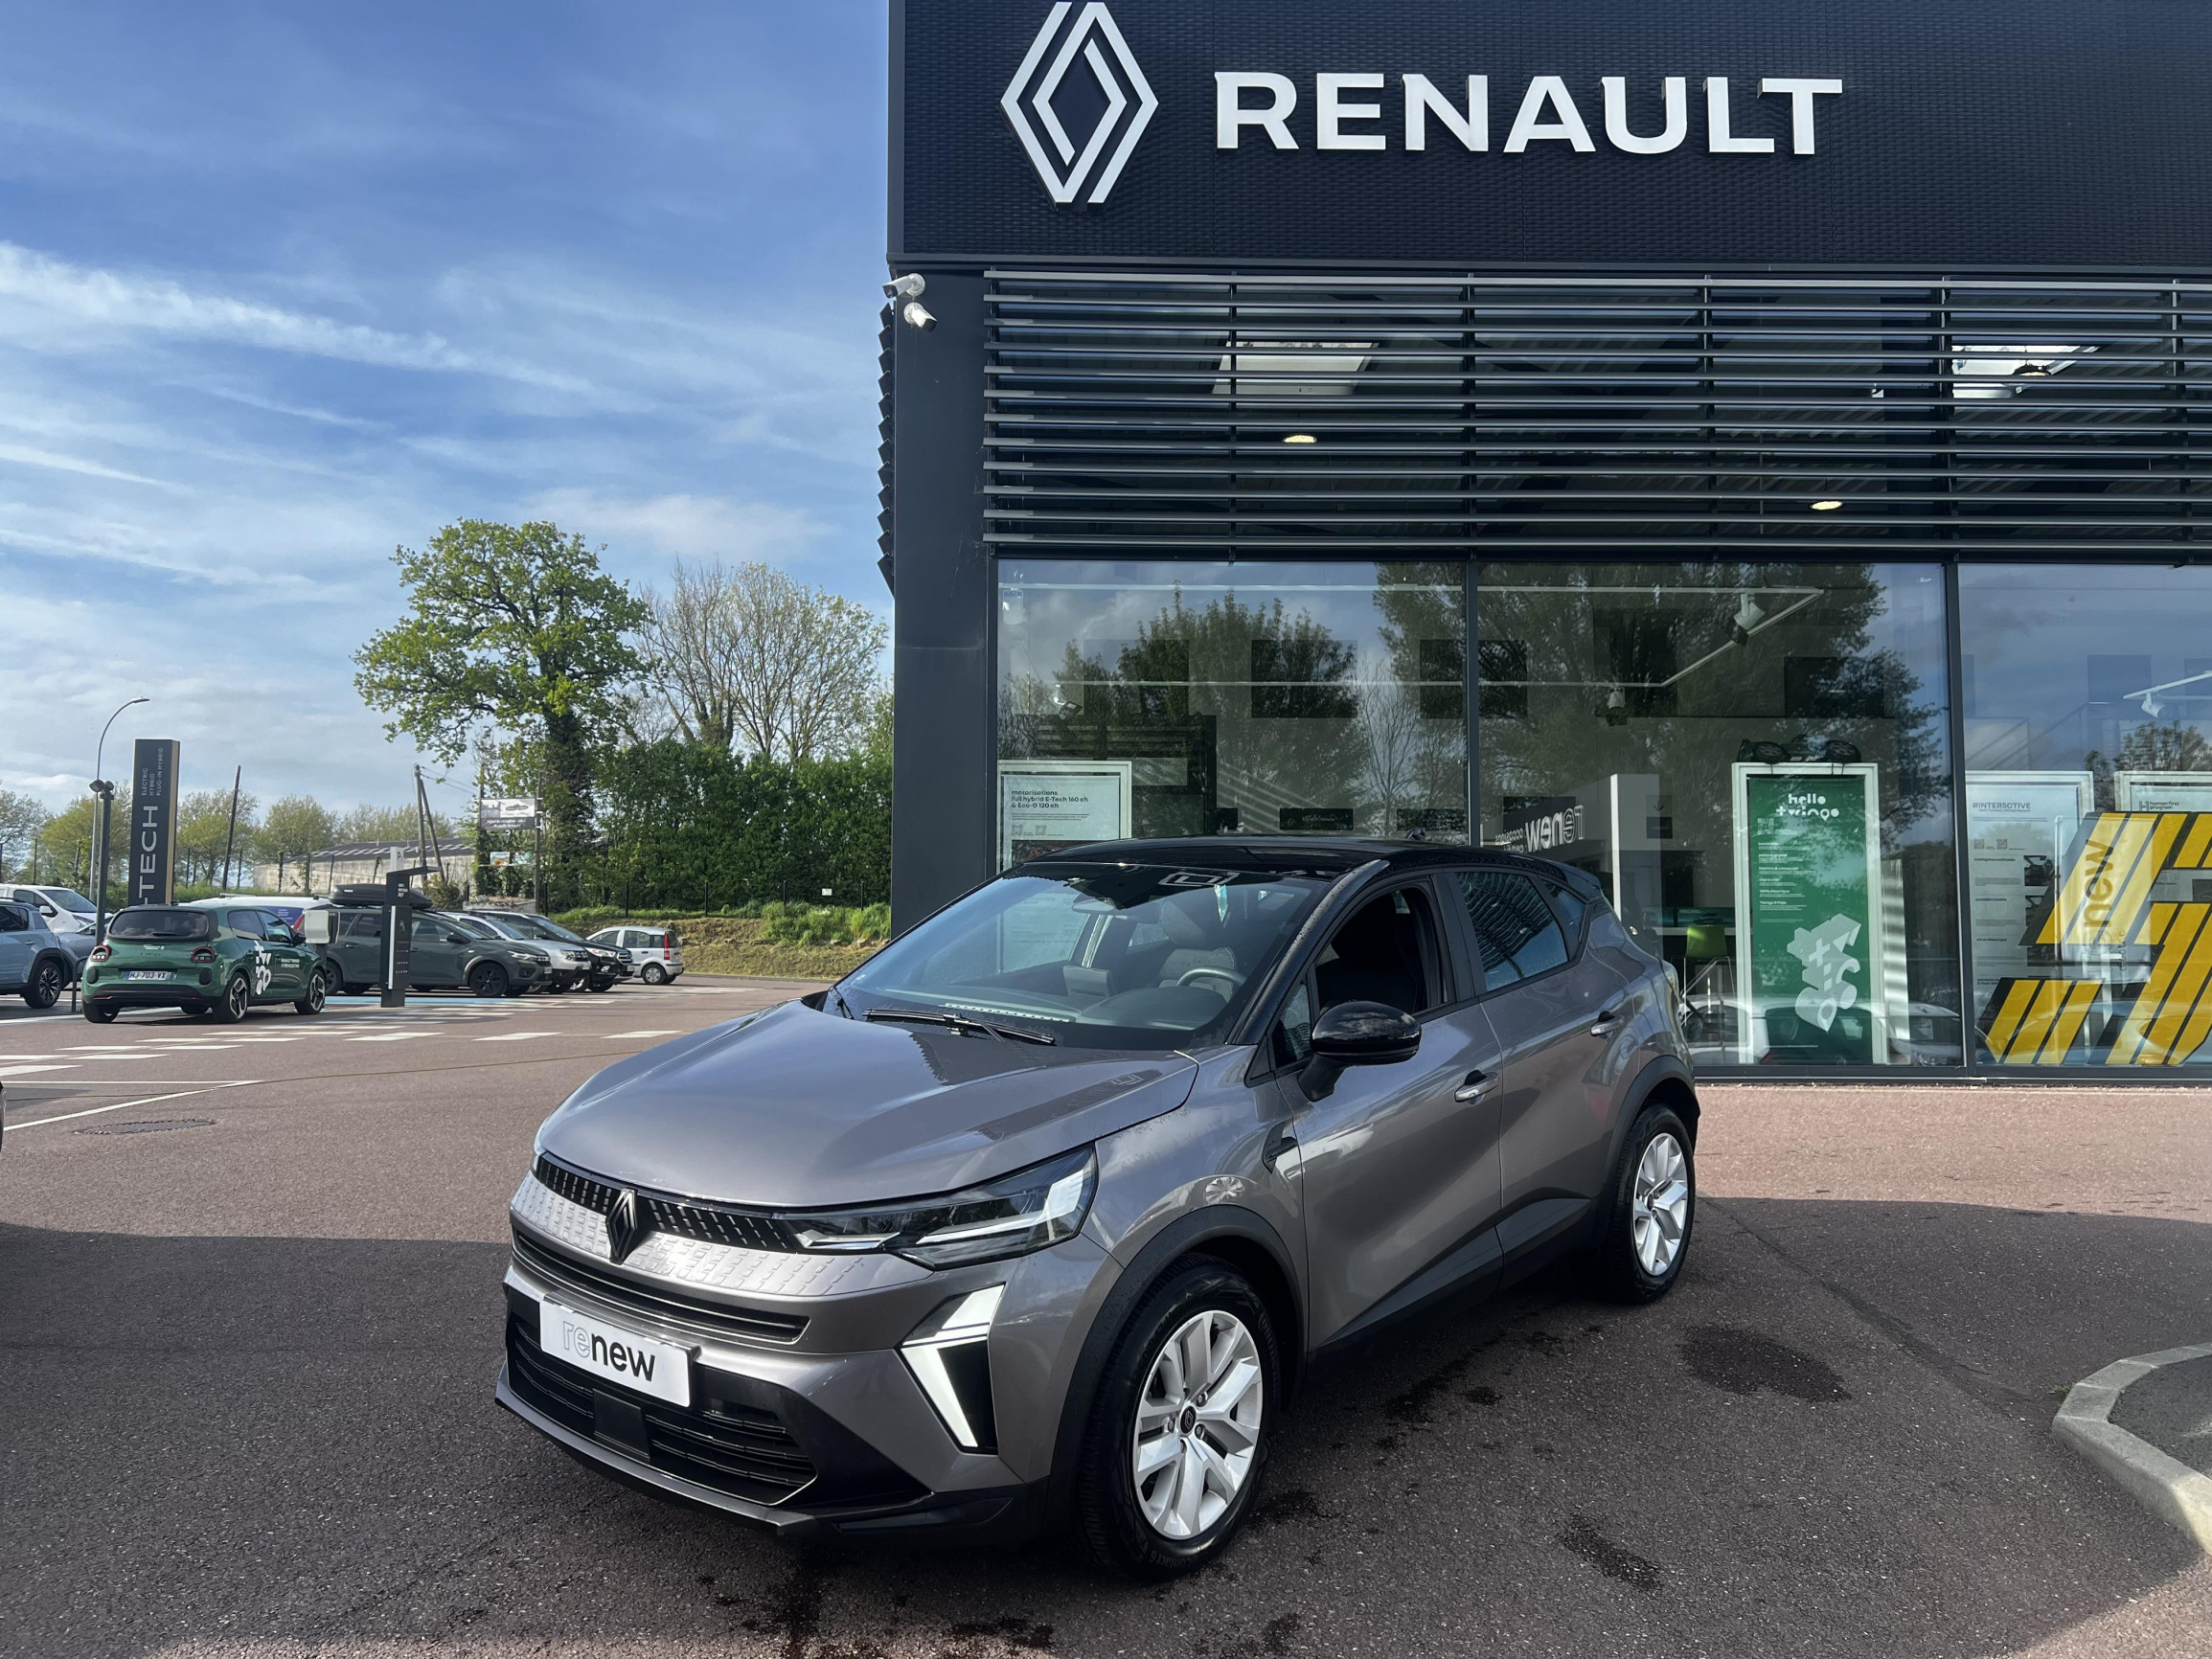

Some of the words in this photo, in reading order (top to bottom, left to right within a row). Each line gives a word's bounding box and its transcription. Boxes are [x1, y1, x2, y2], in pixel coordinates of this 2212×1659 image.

[1214, 71, 1843, 155] RENAULT
[1788, 793, 1827, 805] hello
[138, 805, 159, 905] -TECH
[562, 1320, 656, 1382] renew
